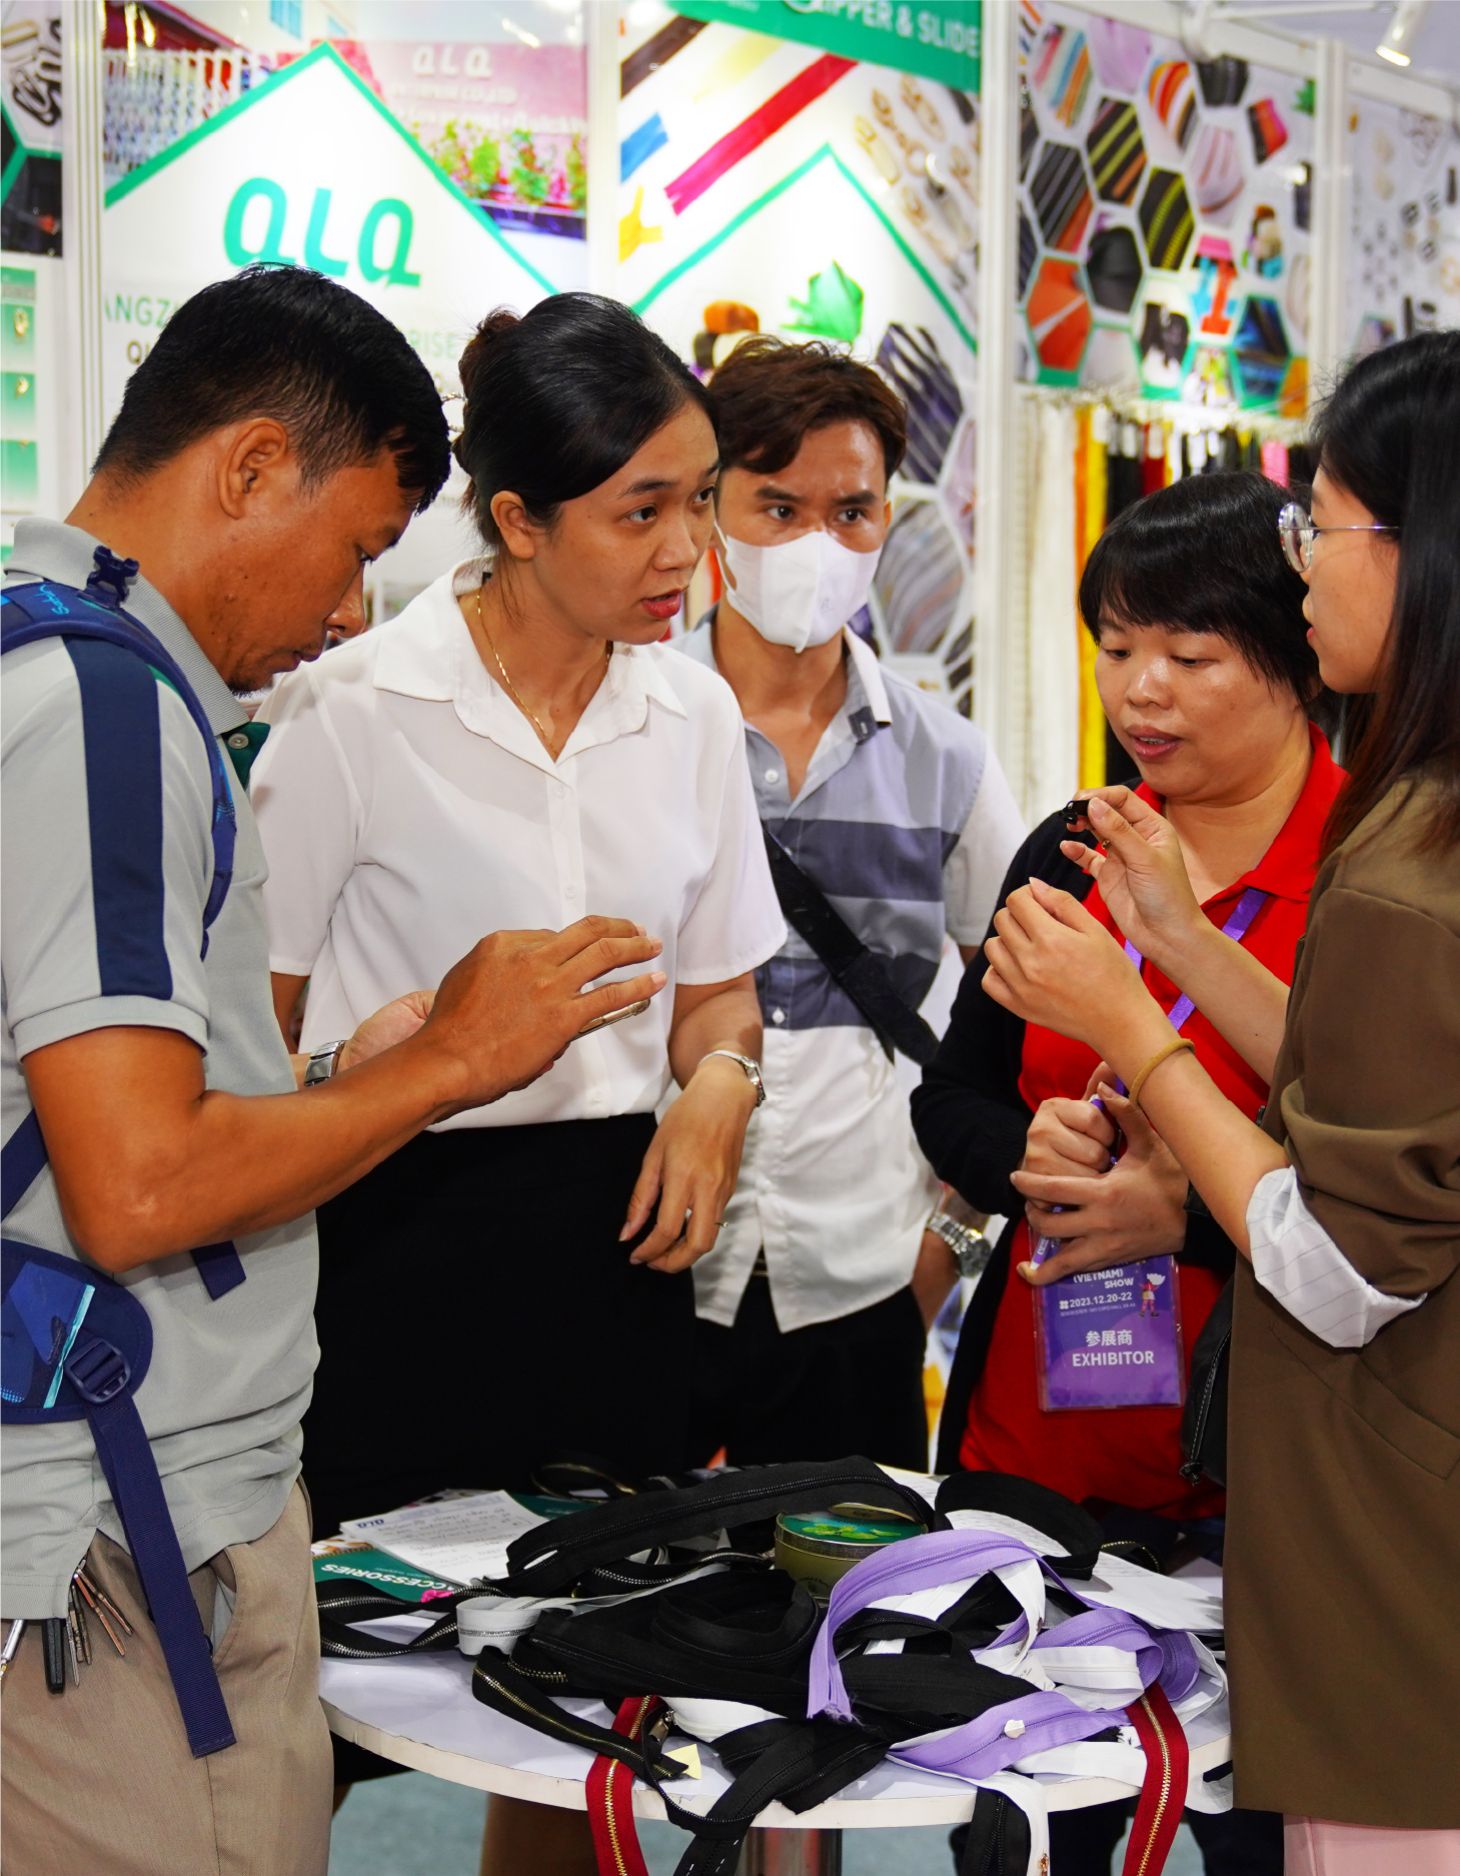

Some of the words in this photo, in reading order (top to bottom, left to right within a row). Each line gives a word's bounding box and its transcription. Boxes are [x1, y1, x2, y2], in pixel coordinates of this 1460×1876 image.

[896, 5, 913, 37] &
[223, 177, 421, 288] QLQ
[1104, 1277, 1134, 1289] SHOW
[1070, 1292, 1132, 1308] 2023.12.20-22
[1085, 1330, 1133, 1347] 参展商
[1072, 1351, 1154, 1367] EXHIBITOR
